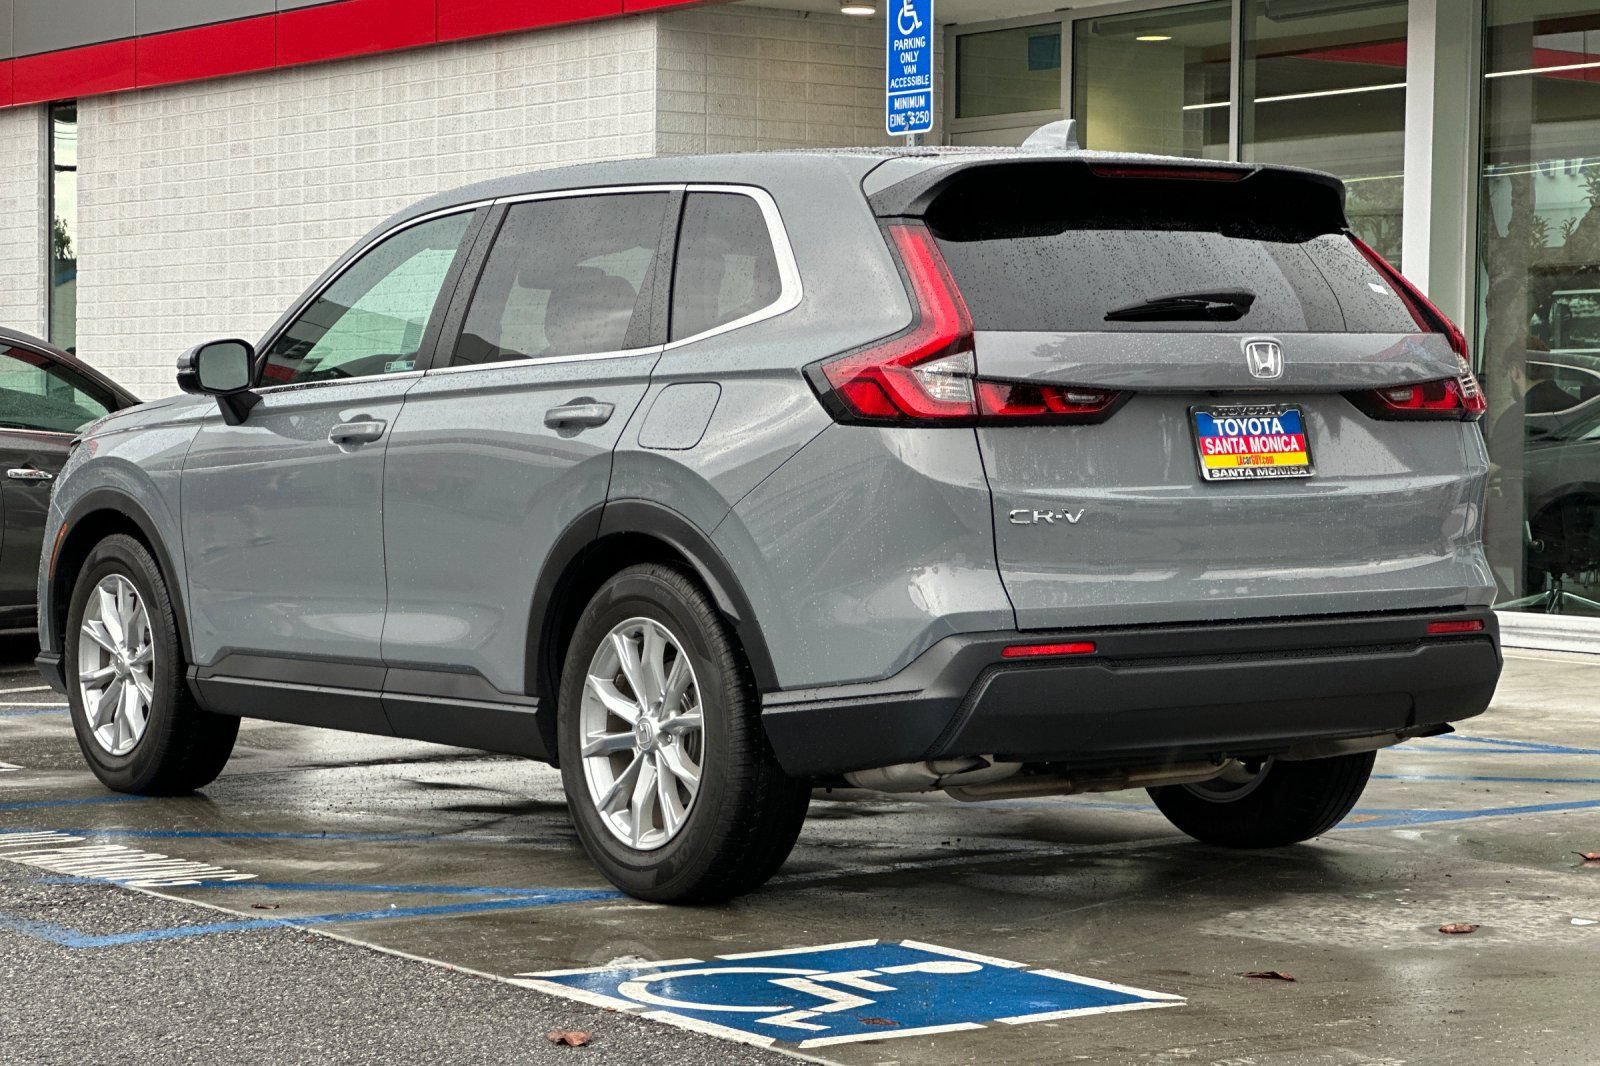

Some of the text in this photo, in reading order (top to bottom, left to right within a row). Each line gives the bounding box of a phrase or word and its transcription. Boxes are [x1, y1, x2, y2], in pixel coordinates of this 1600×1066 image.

[894, 36, 926, 50] PARKING
[900, 51, 919, 63] ONLY
[904, 64, 916, 74] VAN
[890, 75, 929, 88] ACCESSIBLE
[894, 95, 925, 110] MINIMUM
[1213, 418, 1285, 436] TOYOTA
[1205, 435, 1300, 454] SANTA MONICA
[1211, 466, 1307, 478] SANTA MONICA
[1009, 508, 1085, 524] CR-V
